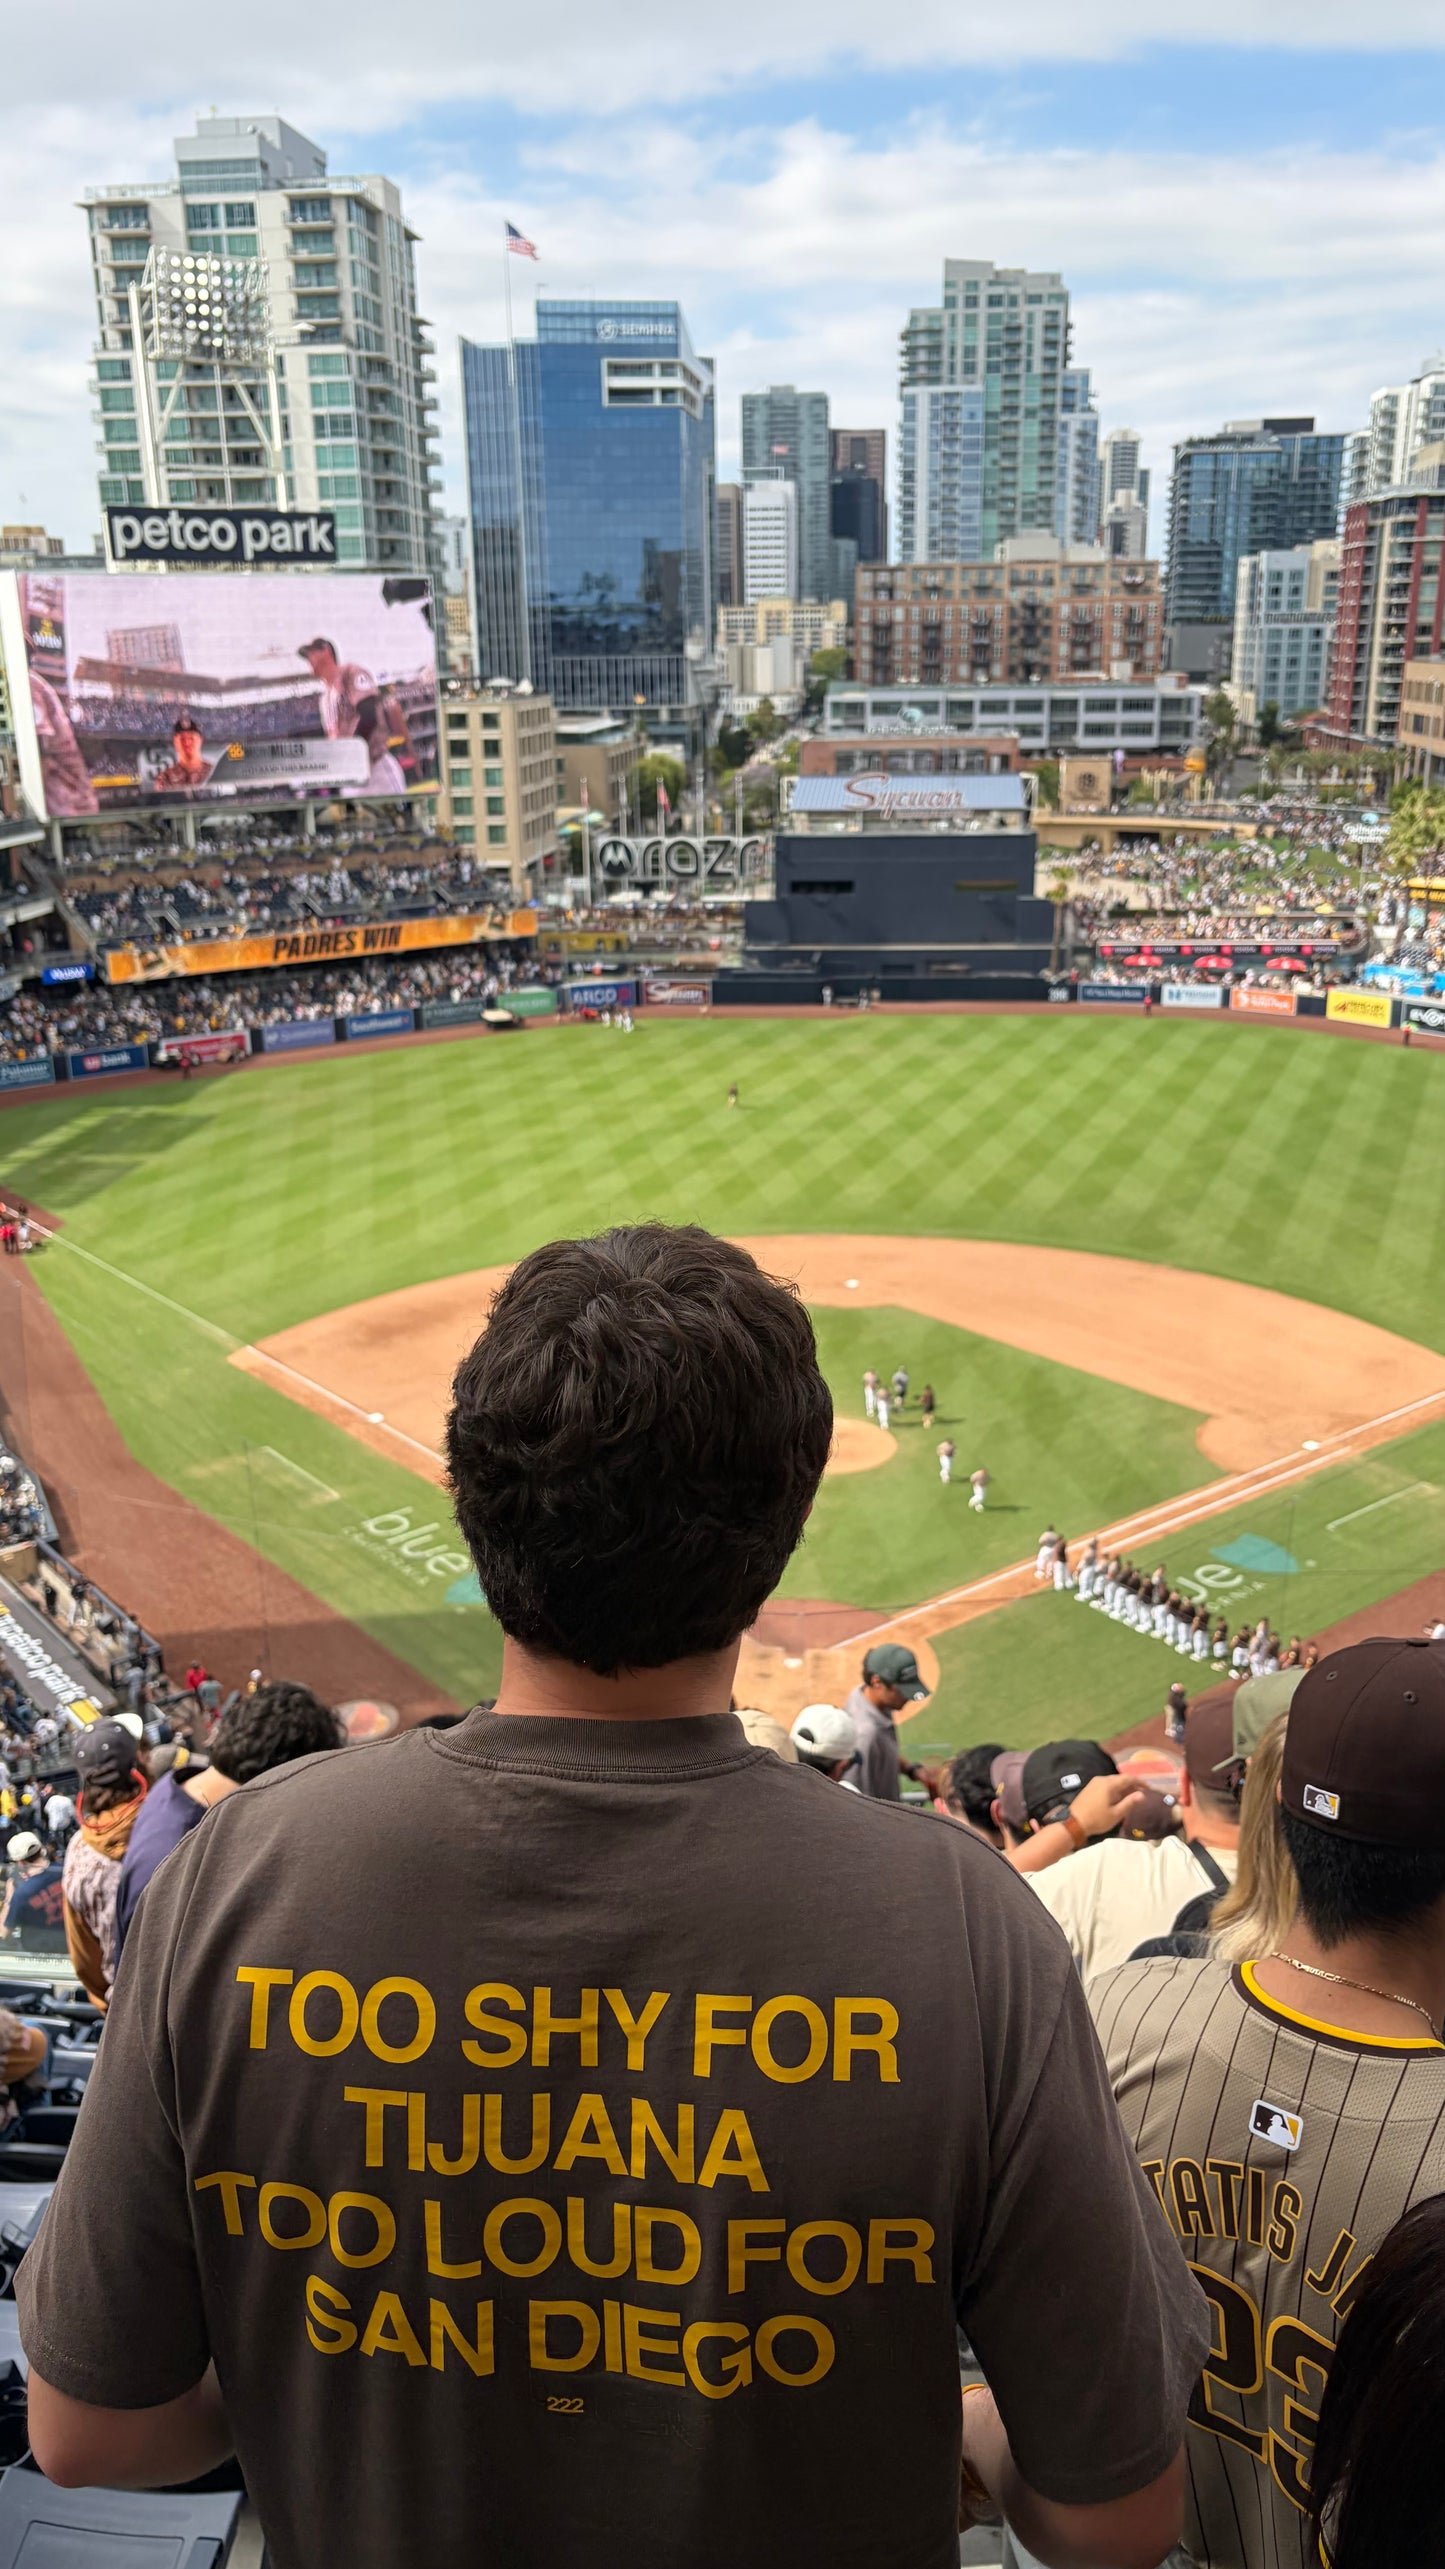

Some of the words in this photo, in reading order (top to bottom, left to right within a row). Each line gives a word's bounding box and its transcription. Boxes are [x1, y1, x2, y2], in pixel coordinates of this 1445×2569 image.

[112, 511, 238, 558] petco
[241, 517, 334, 561] park
[844, 771, 964, 820] Sycuan
[641, 837, 761, 877] razr
[273, 931, 358, 959] PADRES
[363, 925, 402, 950] WIN
[361, 1506, 470, 1576] blue
[27, 1662, 88, 1705] park
[236, 1966, 437, 2064] TOO
[461, 1982, 670, 2072] SHY
[692, 1993, 901, 2084] FOR
[343, 2086, 771, 2193] TIJUANA
[195, 2171, 397, 2269] TOO
[424, 2196, 702, 2286] LOUD
[727, 2218, 937, 2297] FOR
[305, 2274, 495, 2377] SAN
[528, 2299, 836, 2400] DIEGO
[546, 2396, 584, 2413] 222
